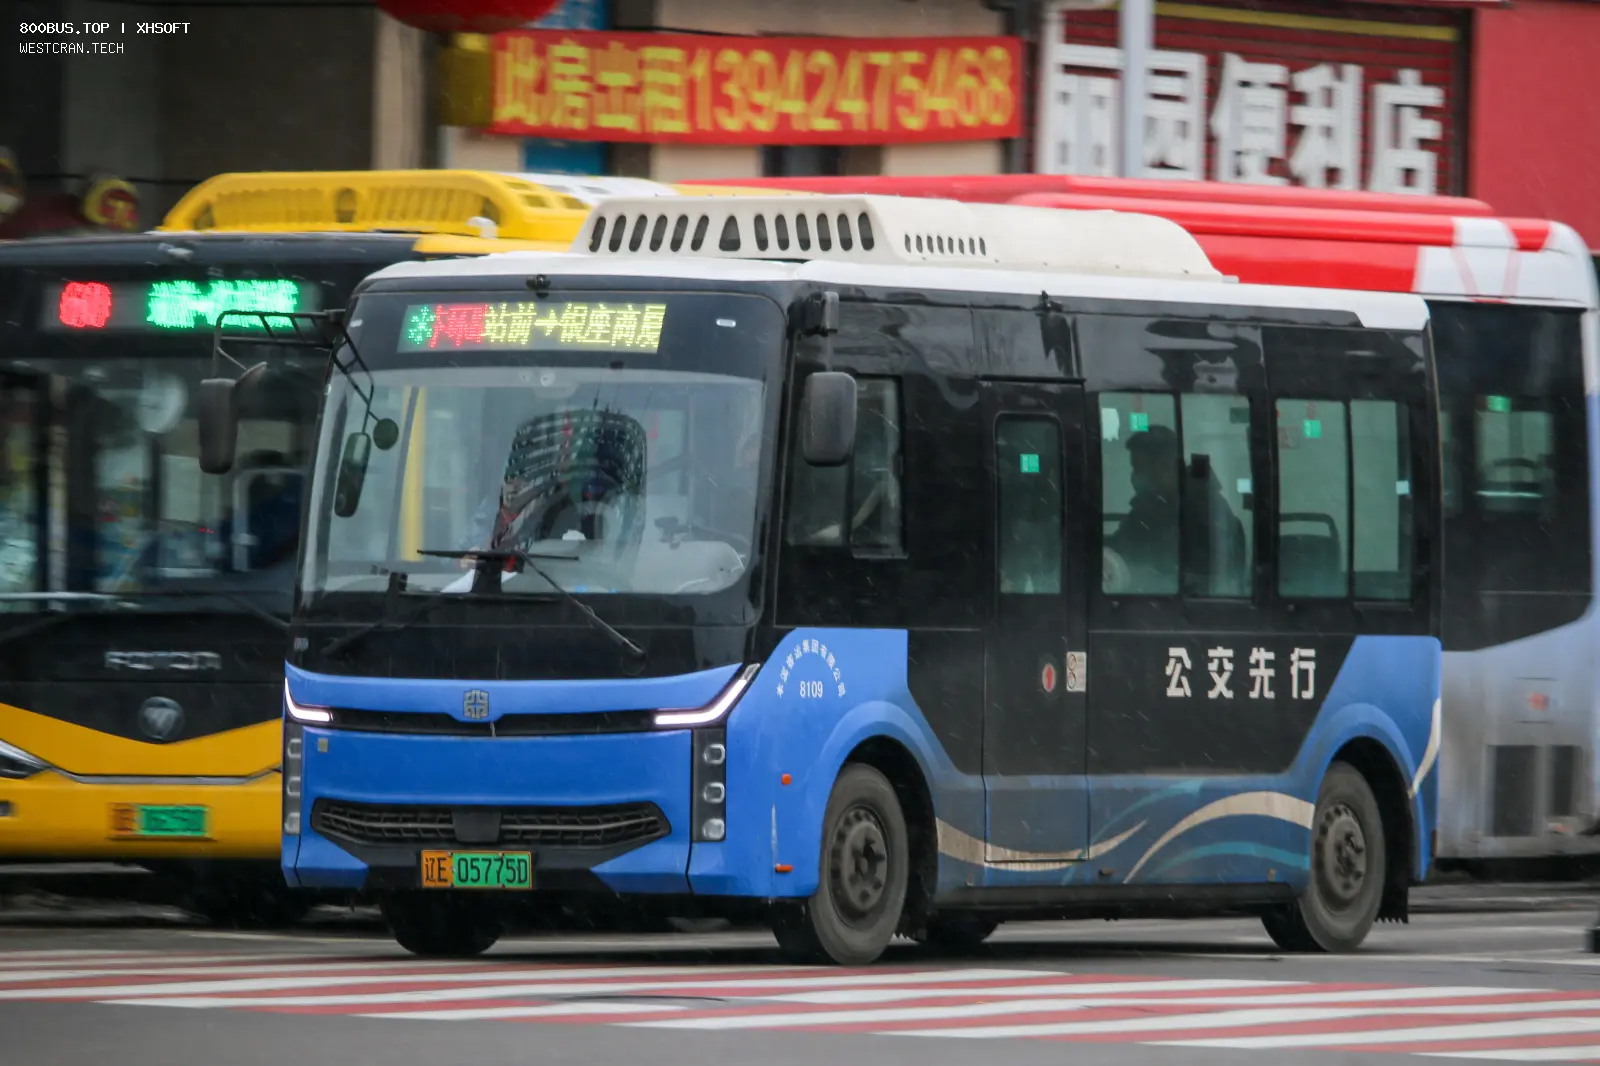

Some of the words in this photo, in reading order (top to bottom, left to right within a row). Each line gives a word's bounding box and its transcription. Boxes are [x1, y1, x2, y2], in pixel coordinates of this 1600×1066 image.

[799, 680, 824, 698] 8109
[1165, 646, 1317, 700] 公交先行
